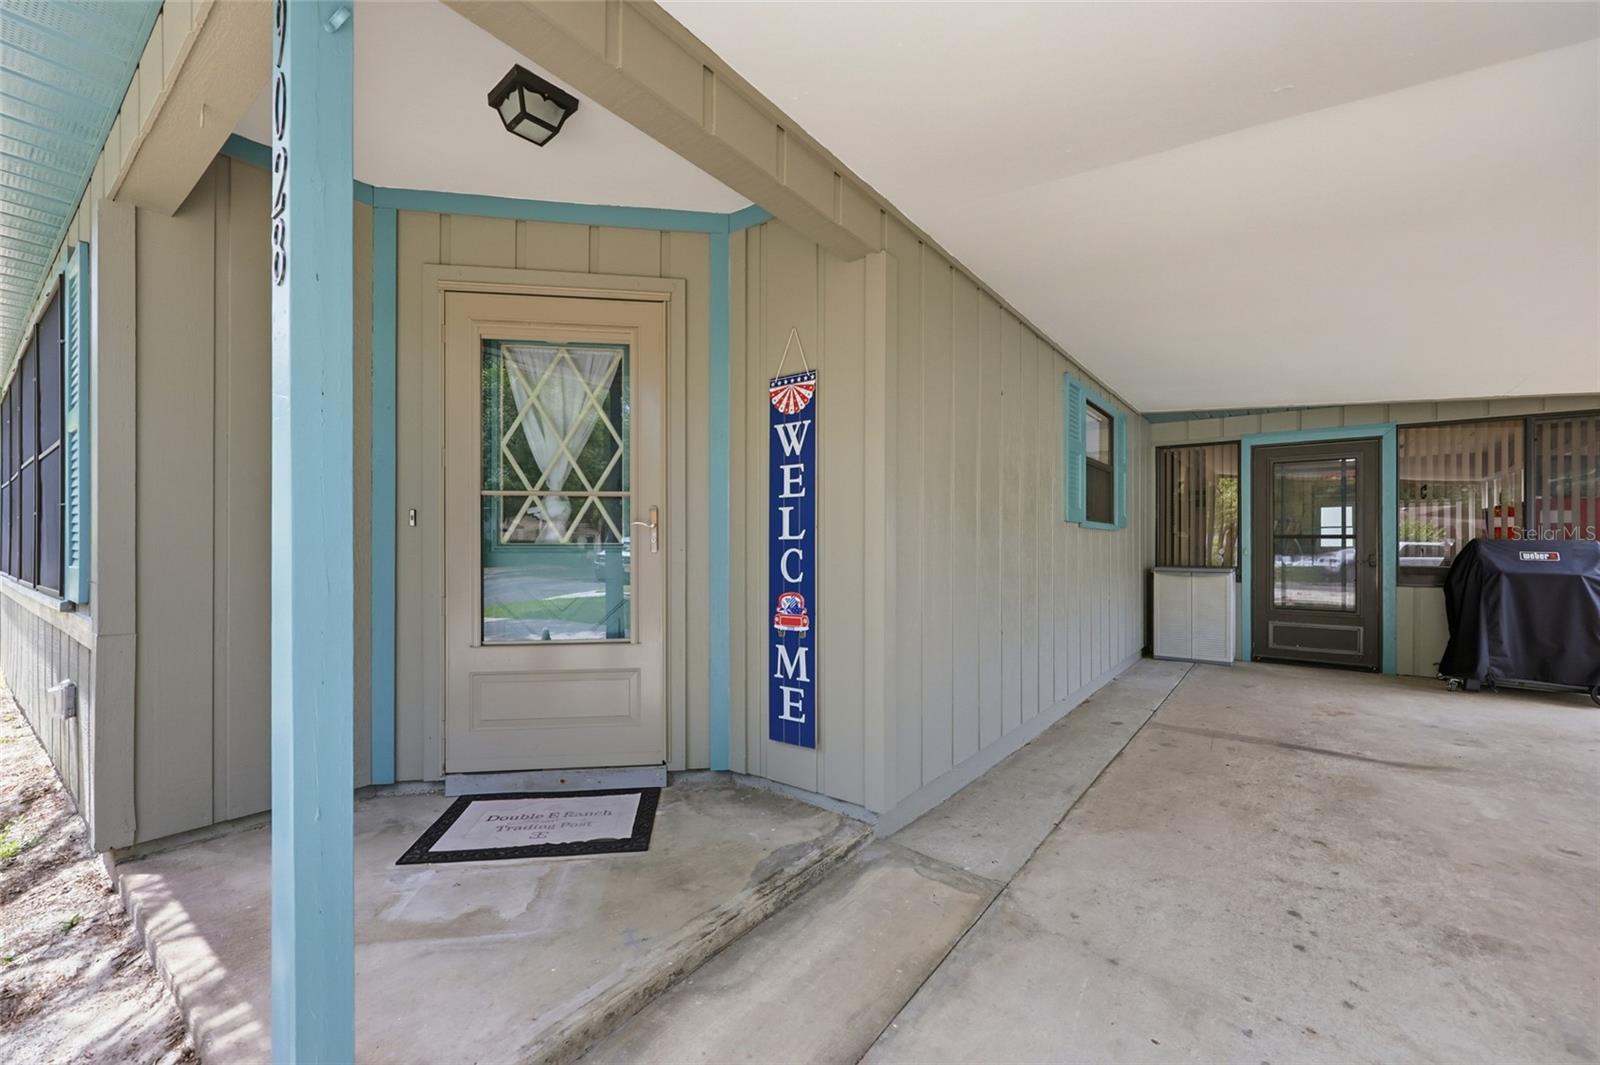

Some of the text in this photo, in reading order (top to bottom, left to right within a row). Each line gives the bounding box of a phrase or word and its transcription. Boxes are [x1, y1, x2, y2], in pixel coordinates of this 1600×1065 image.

[1522, 552, 1549, 560] weber
[485, 812, 545, 822] Double
[563, 810, 612, 818] Ranch
[496, 821, 592, 832] Trading Post
